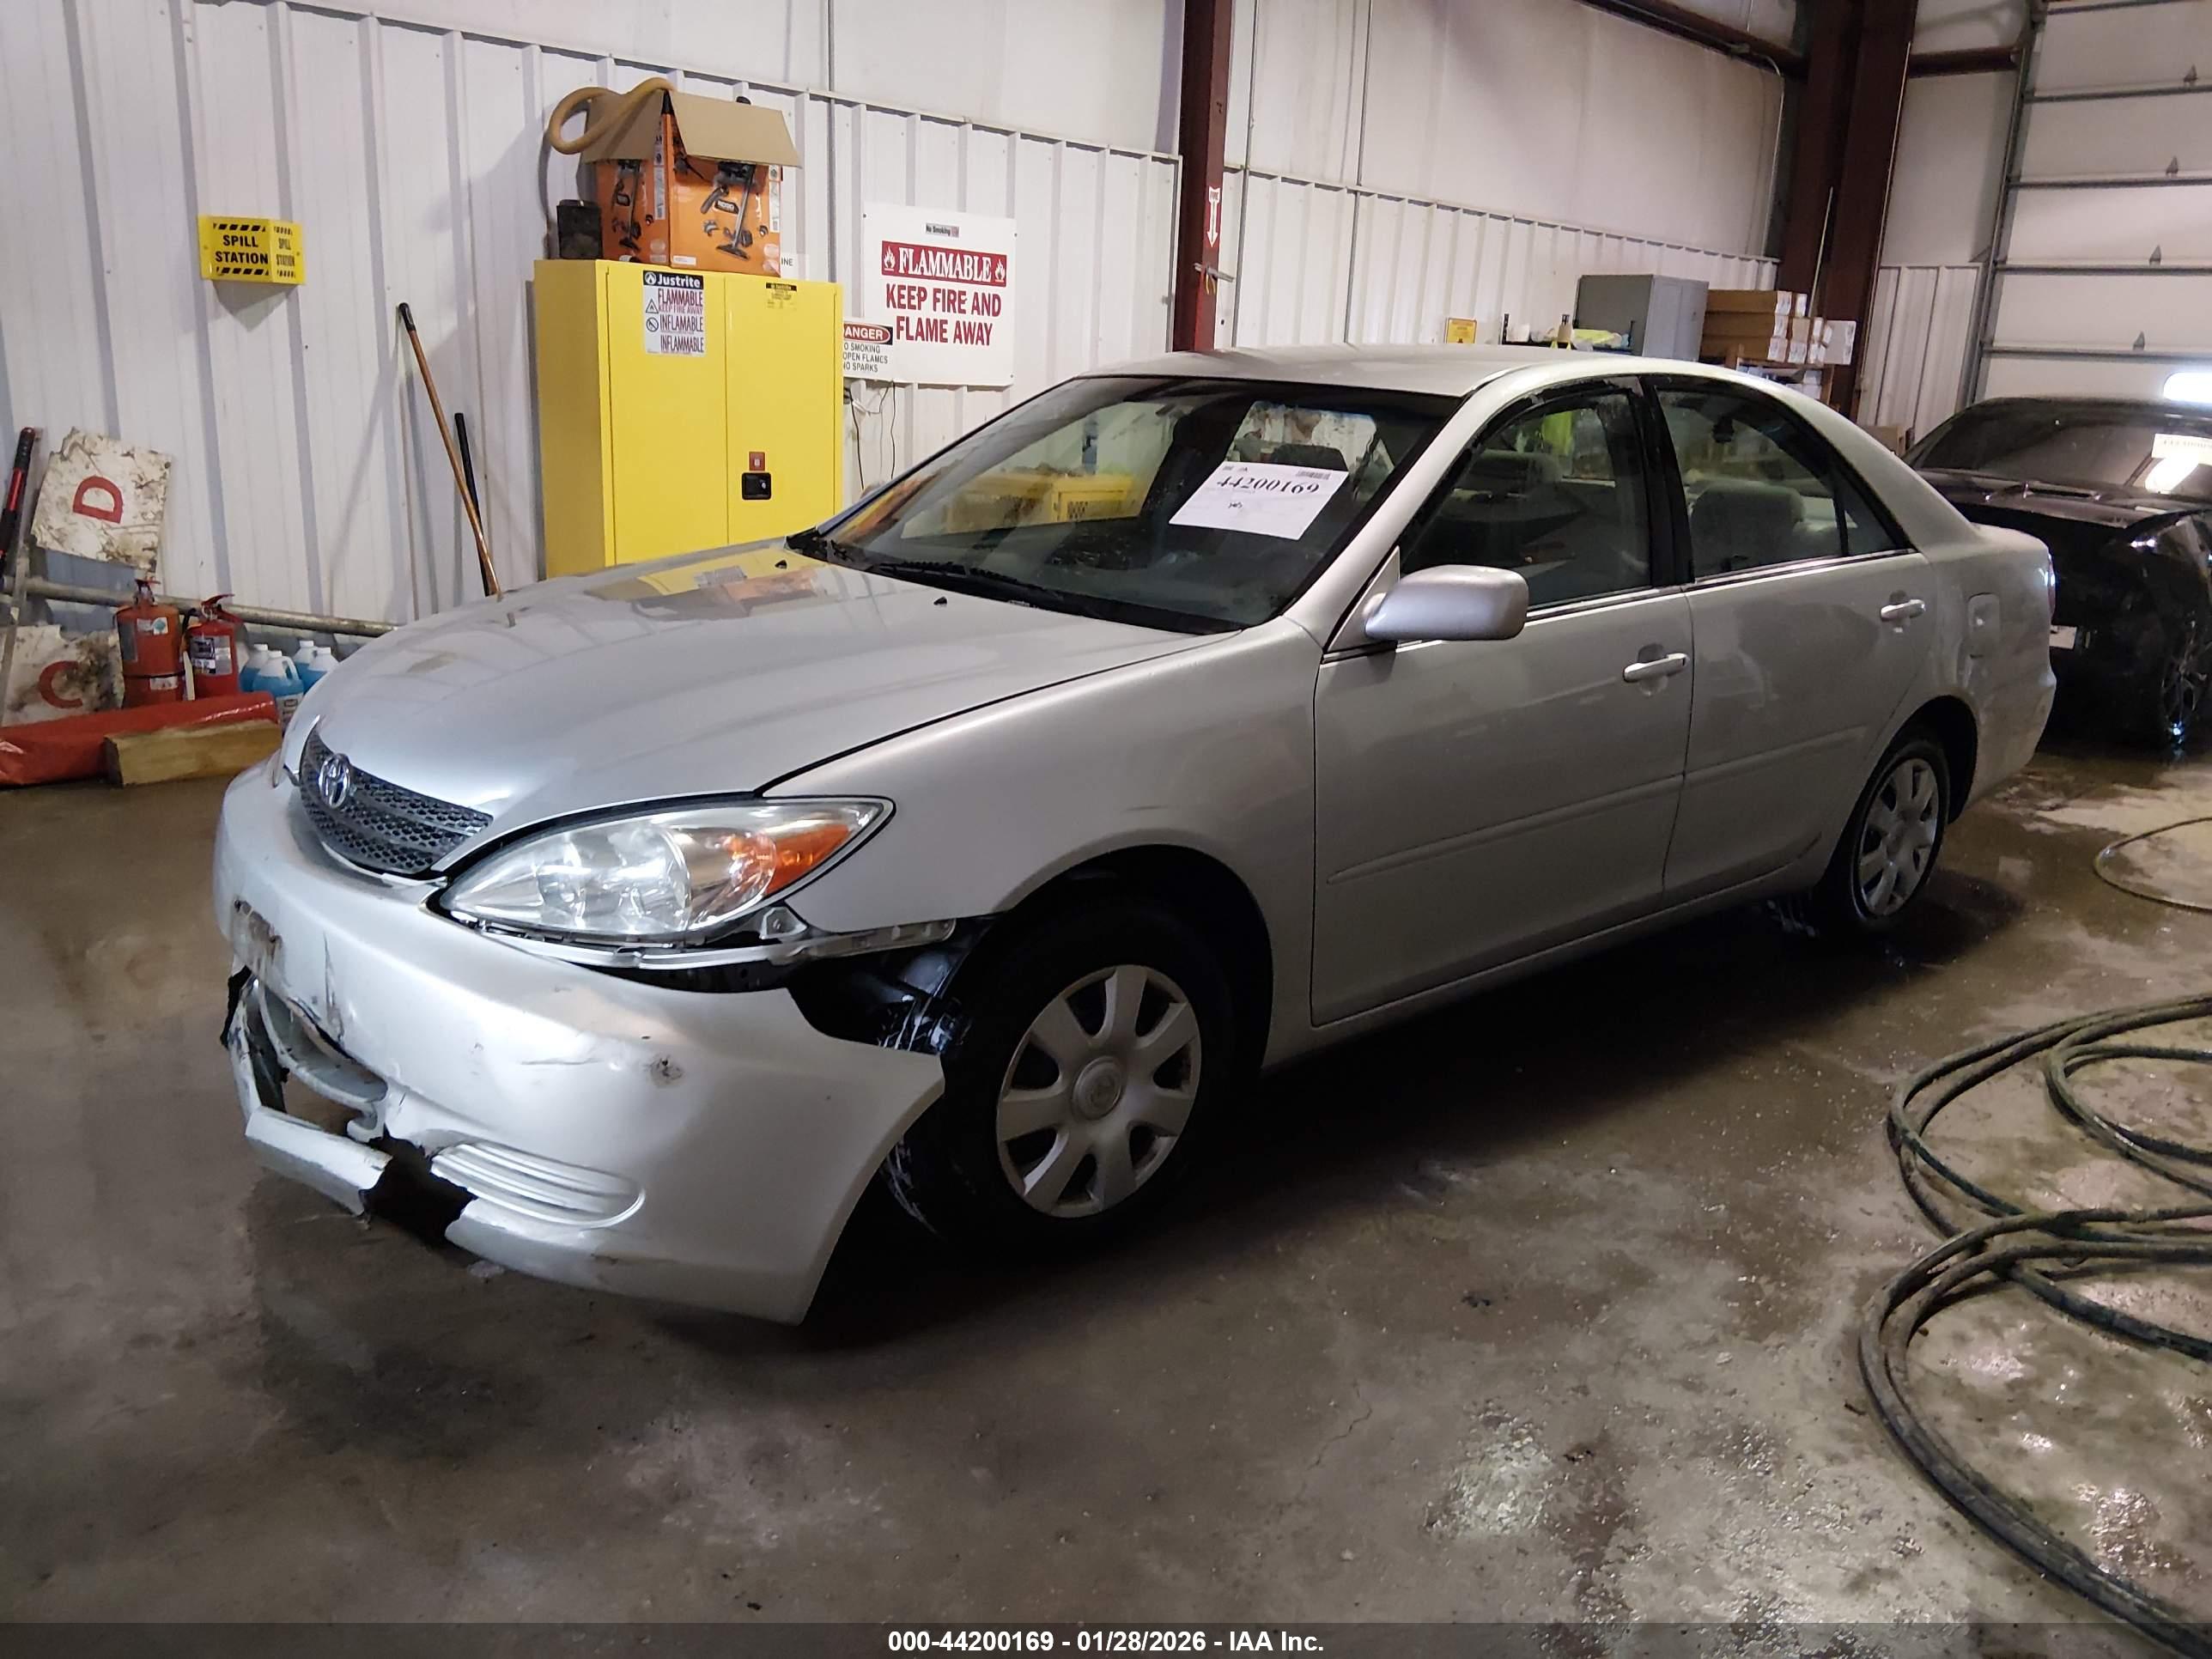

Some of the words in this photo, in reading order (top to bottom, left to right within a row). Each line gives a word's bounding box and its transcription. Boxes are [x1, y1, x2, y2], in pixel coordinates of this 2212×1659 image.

[222, 234, 259, 247] SPILL
[933, 226, 951, 237] Smoking
[215, 251, 269, 264] STATION
[898, 246, 992, 283] FLAMMABLE
[658, 274, 701, 289] Justrite
[658, 288, 703, 307] FLAMMABLE
[886, 283, 927, 311] KEEP
[933, 288, 968, 314] FIRE
[971, 292, 1002, 318] AND
[659, 314, 704, 332] INFLAMABLE
[896, 316, 949, 343] FLAME
[953, 320, 993, 346] AWAY
[845, 325, 884, 340] ANGER
[660, 334, 705, 353] INFLAMMABLE
[850, 343, 881, 354] SMOKING
[843, 351, 860, 362] OPEN
[862, 353, 889, 364] FLAMES
[852, 362, 878, 373] SPARKS
[1216, 476, 1321, 495] 44200169
[72, 476, 124, 524] D
[39, 660, 83, 708] C
